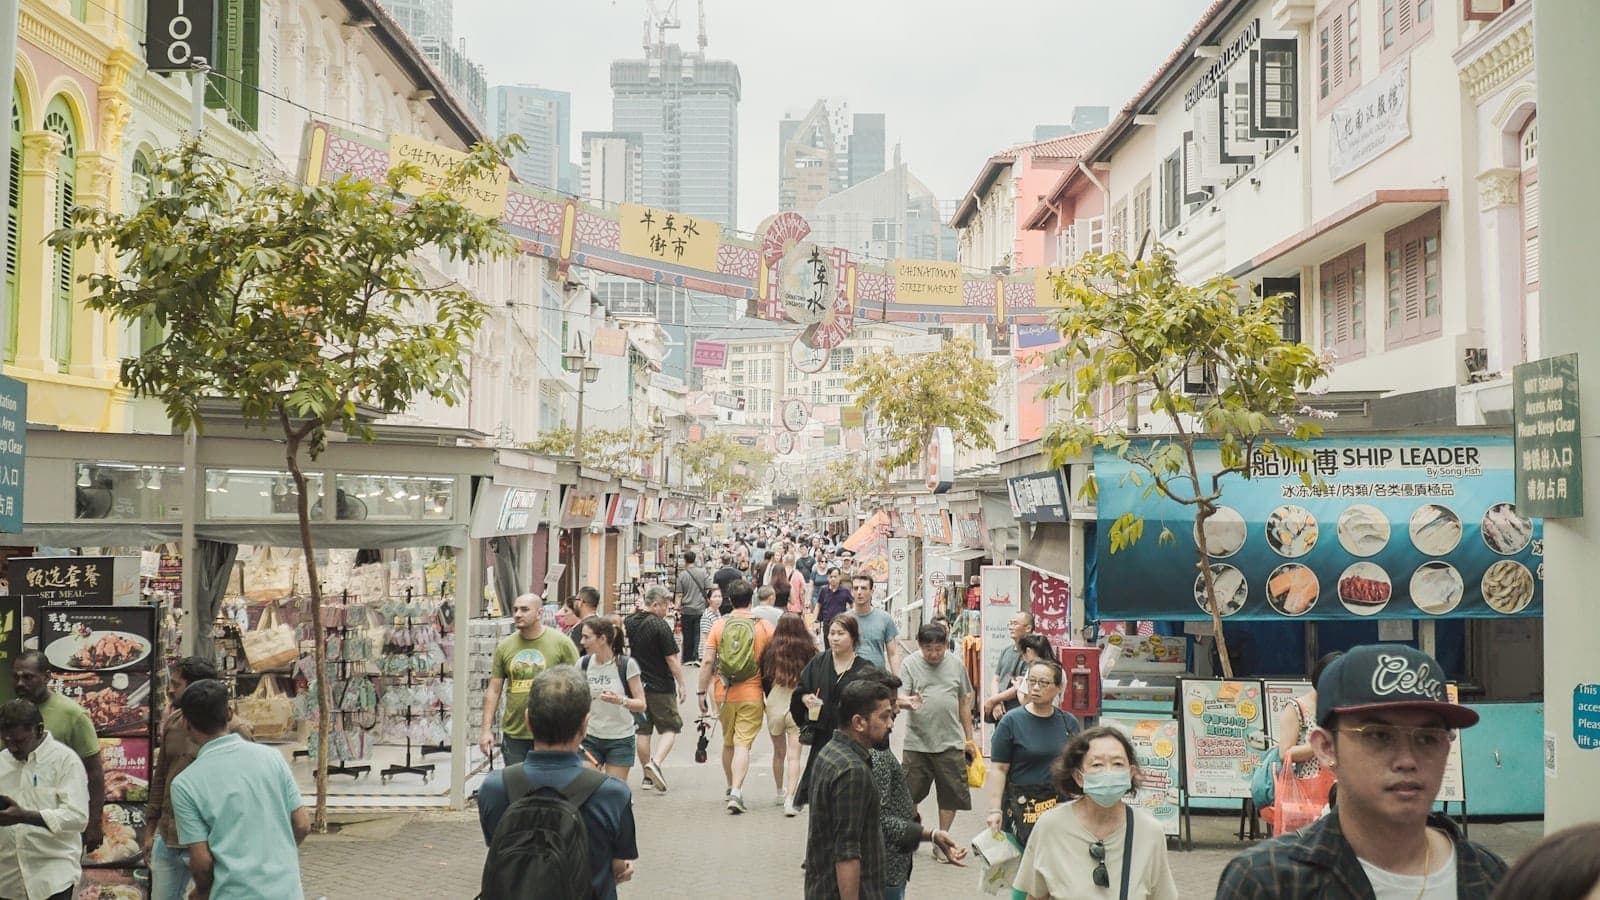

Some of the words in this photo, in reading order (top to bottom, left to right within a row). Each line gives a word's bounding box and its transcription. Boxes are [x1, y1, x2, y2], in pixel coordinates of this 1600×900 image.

[1213, 18, 1260, 80] COLLECTION
[398, 143, 503, 185] CHINAWN
[639, 208, 701, 240] 牛车水
[649, 233, 688, 262] 街市
[899, 264, 959, 280] CHINATOWN
[807, 245, 829, 317] 牛车水
[899, 282, 926, 293] STREET
[927, 284, 959, 295] MARKET
[0, 395, 17, 411] tation
[1525, 401, 1546, 416] Access
[1546, 398, 1563, 413] Area
[2, 416, 15, 432] Area
[1517, 421, 1537, 438] Please
[1537, 419, 1555, 437] Keep
[1555, 417, 1576, 433] Clear
[8, 439, 23, 455] Clear
[1343, 447, 1393, 467] SHIP
[1400, 446, 1480, 466] LEADER
[1426, 467, 1439, 478] By
[1440, 467, 1462, 477] Song
[1464, 467, 1481, 476] Fish
[39, 591, 56, 599] SET
[59, 590, 85, 599] MEAL
[588, 674, 612, 686] evi's
[1579, 684, 1598, 695] This
[1577, 735, 1591, 746] lift
